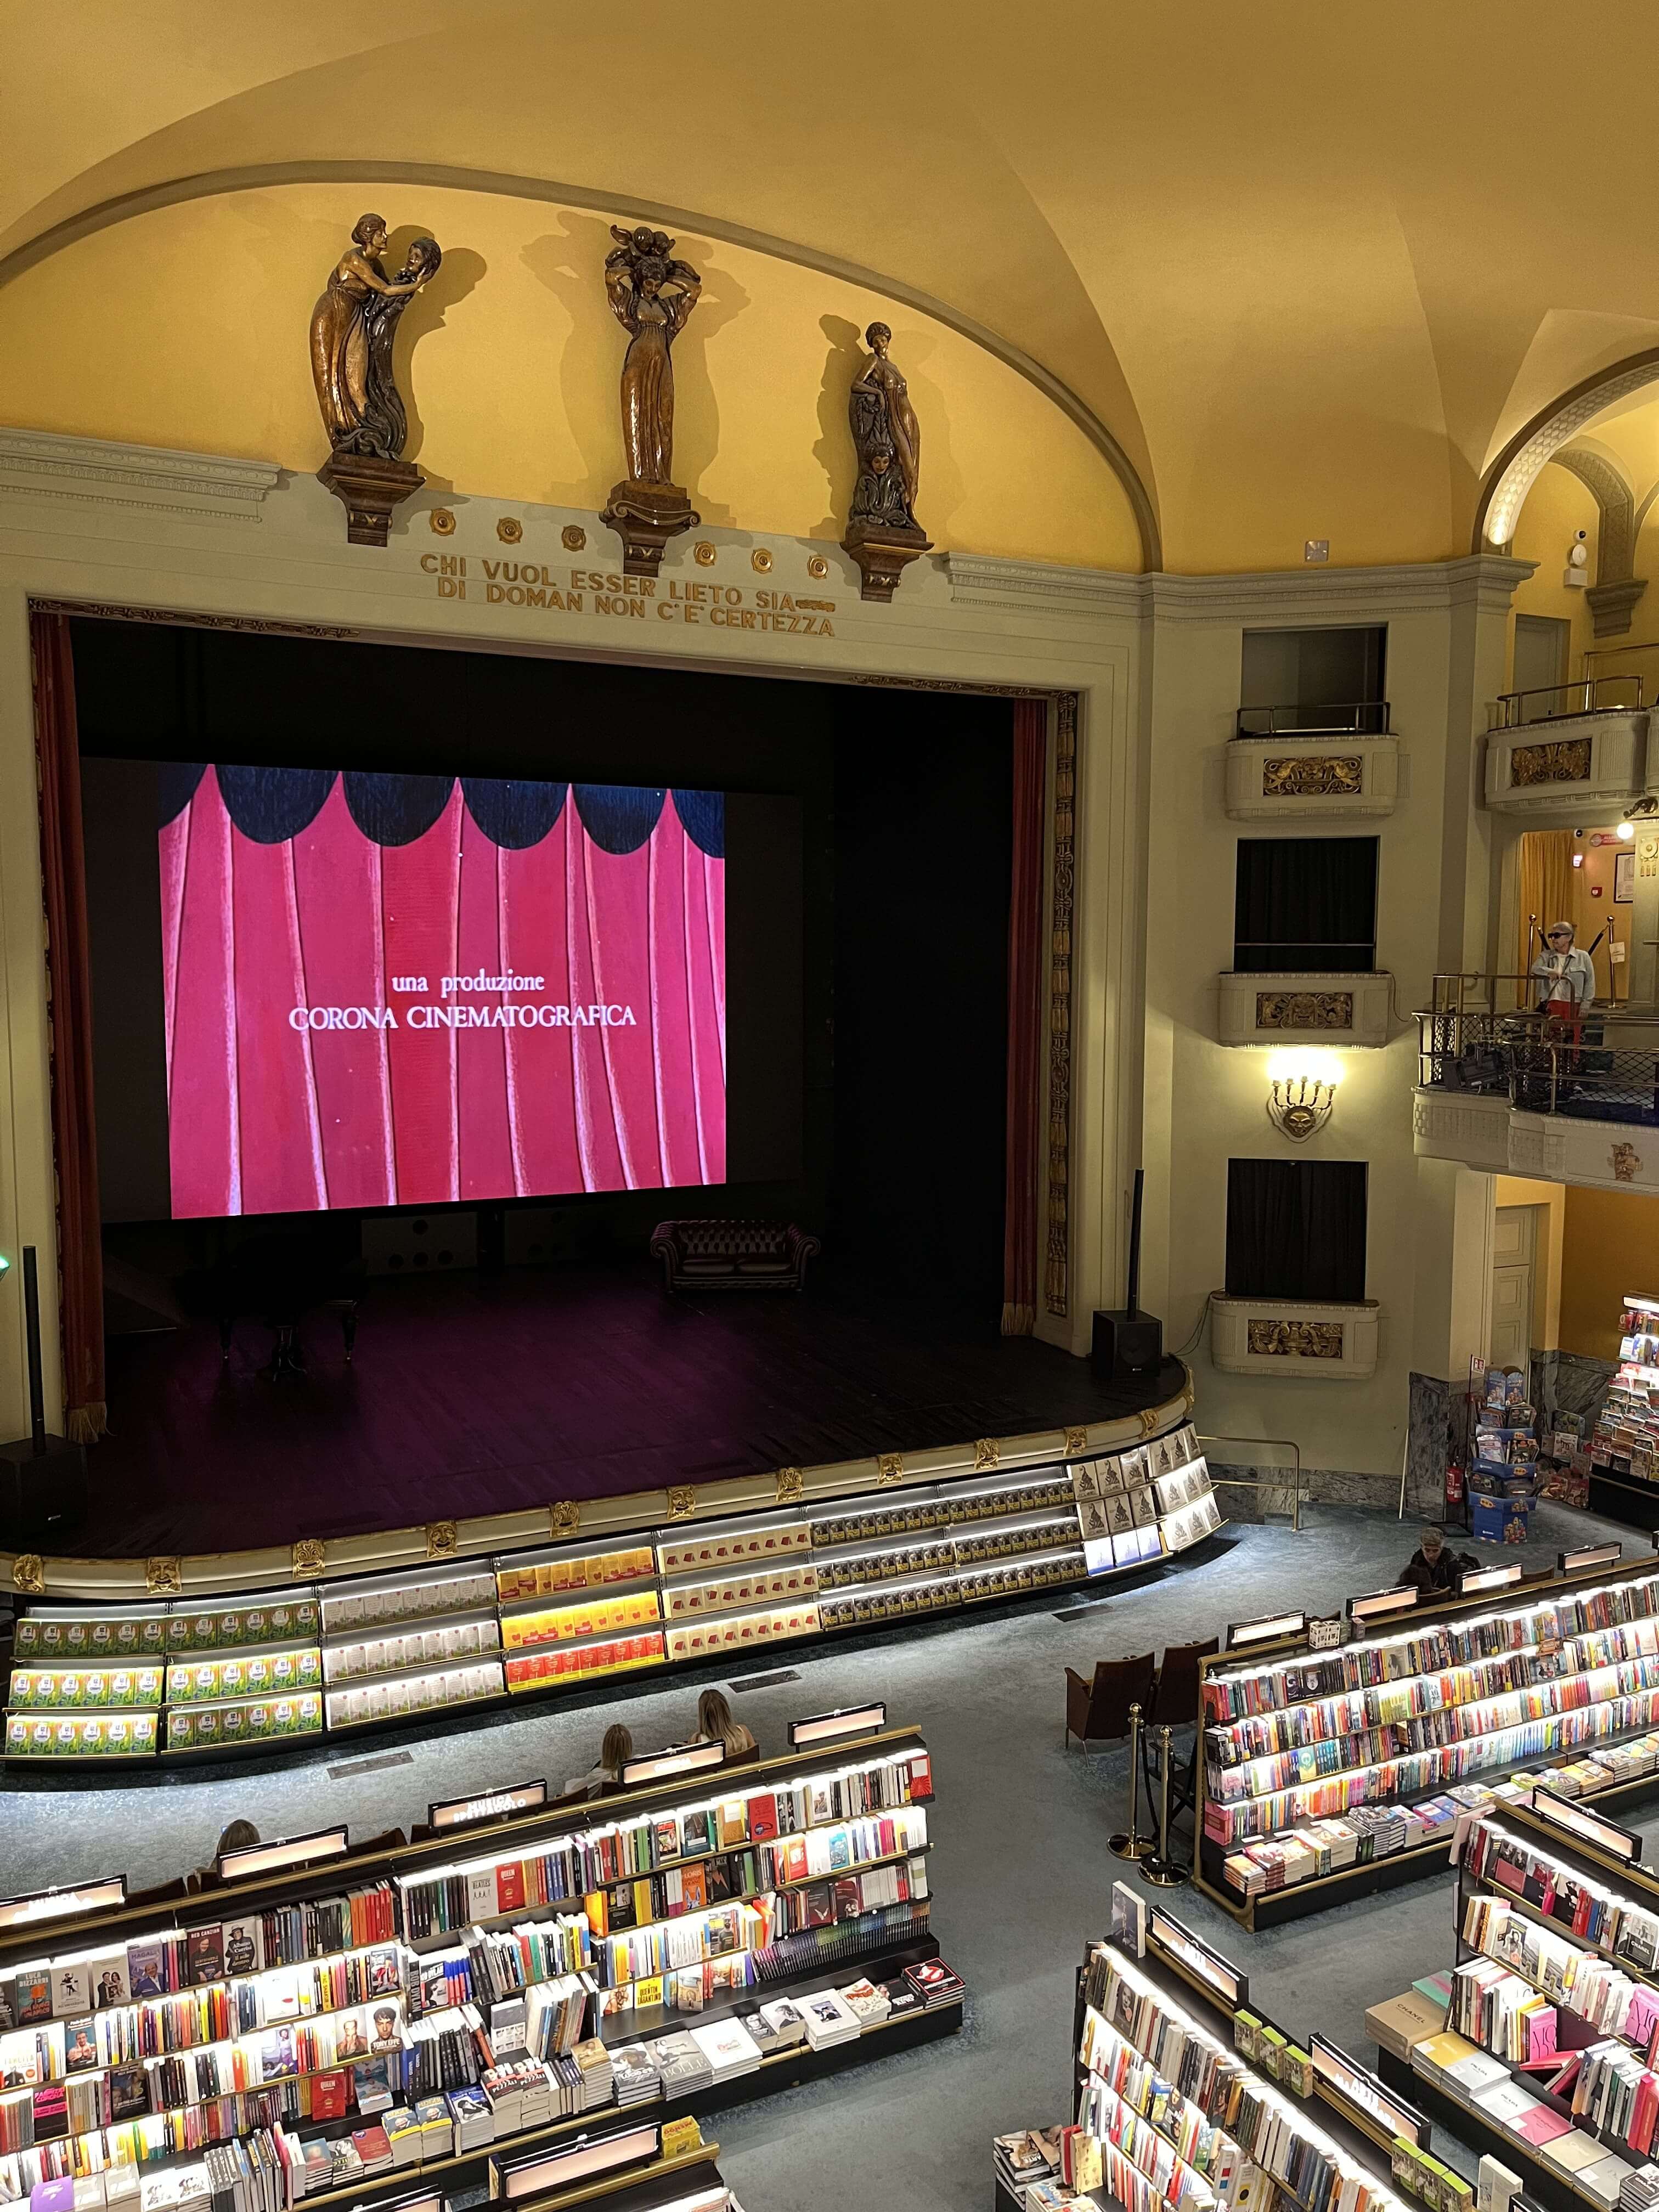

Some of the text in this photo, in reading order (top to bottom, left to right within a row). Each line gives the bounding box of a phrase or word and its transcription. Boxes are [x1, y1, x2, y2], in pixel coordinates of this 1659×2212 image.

[420, 553, 796, 612] CHI VUOL ESSER LIETO SIA
[438, 576, 466, 600] DI
[487, 584, 583, 612] DOMAN
[595, 594, 645, 618] NON
[709, 607, 835, 636] CERTEZZA
[392, 968, 545, 998] una produzione
[289, 1004, 636, 1030] CORONA CINEMATOGRAFICA
[467, 1794, 512, 1812] MUSICA
[472, 1878, 491, 1889] BEATLES
[1397, 2003, 1426, 2024] CHANEL
[663, 2058, 708, 2078] BOLLE
